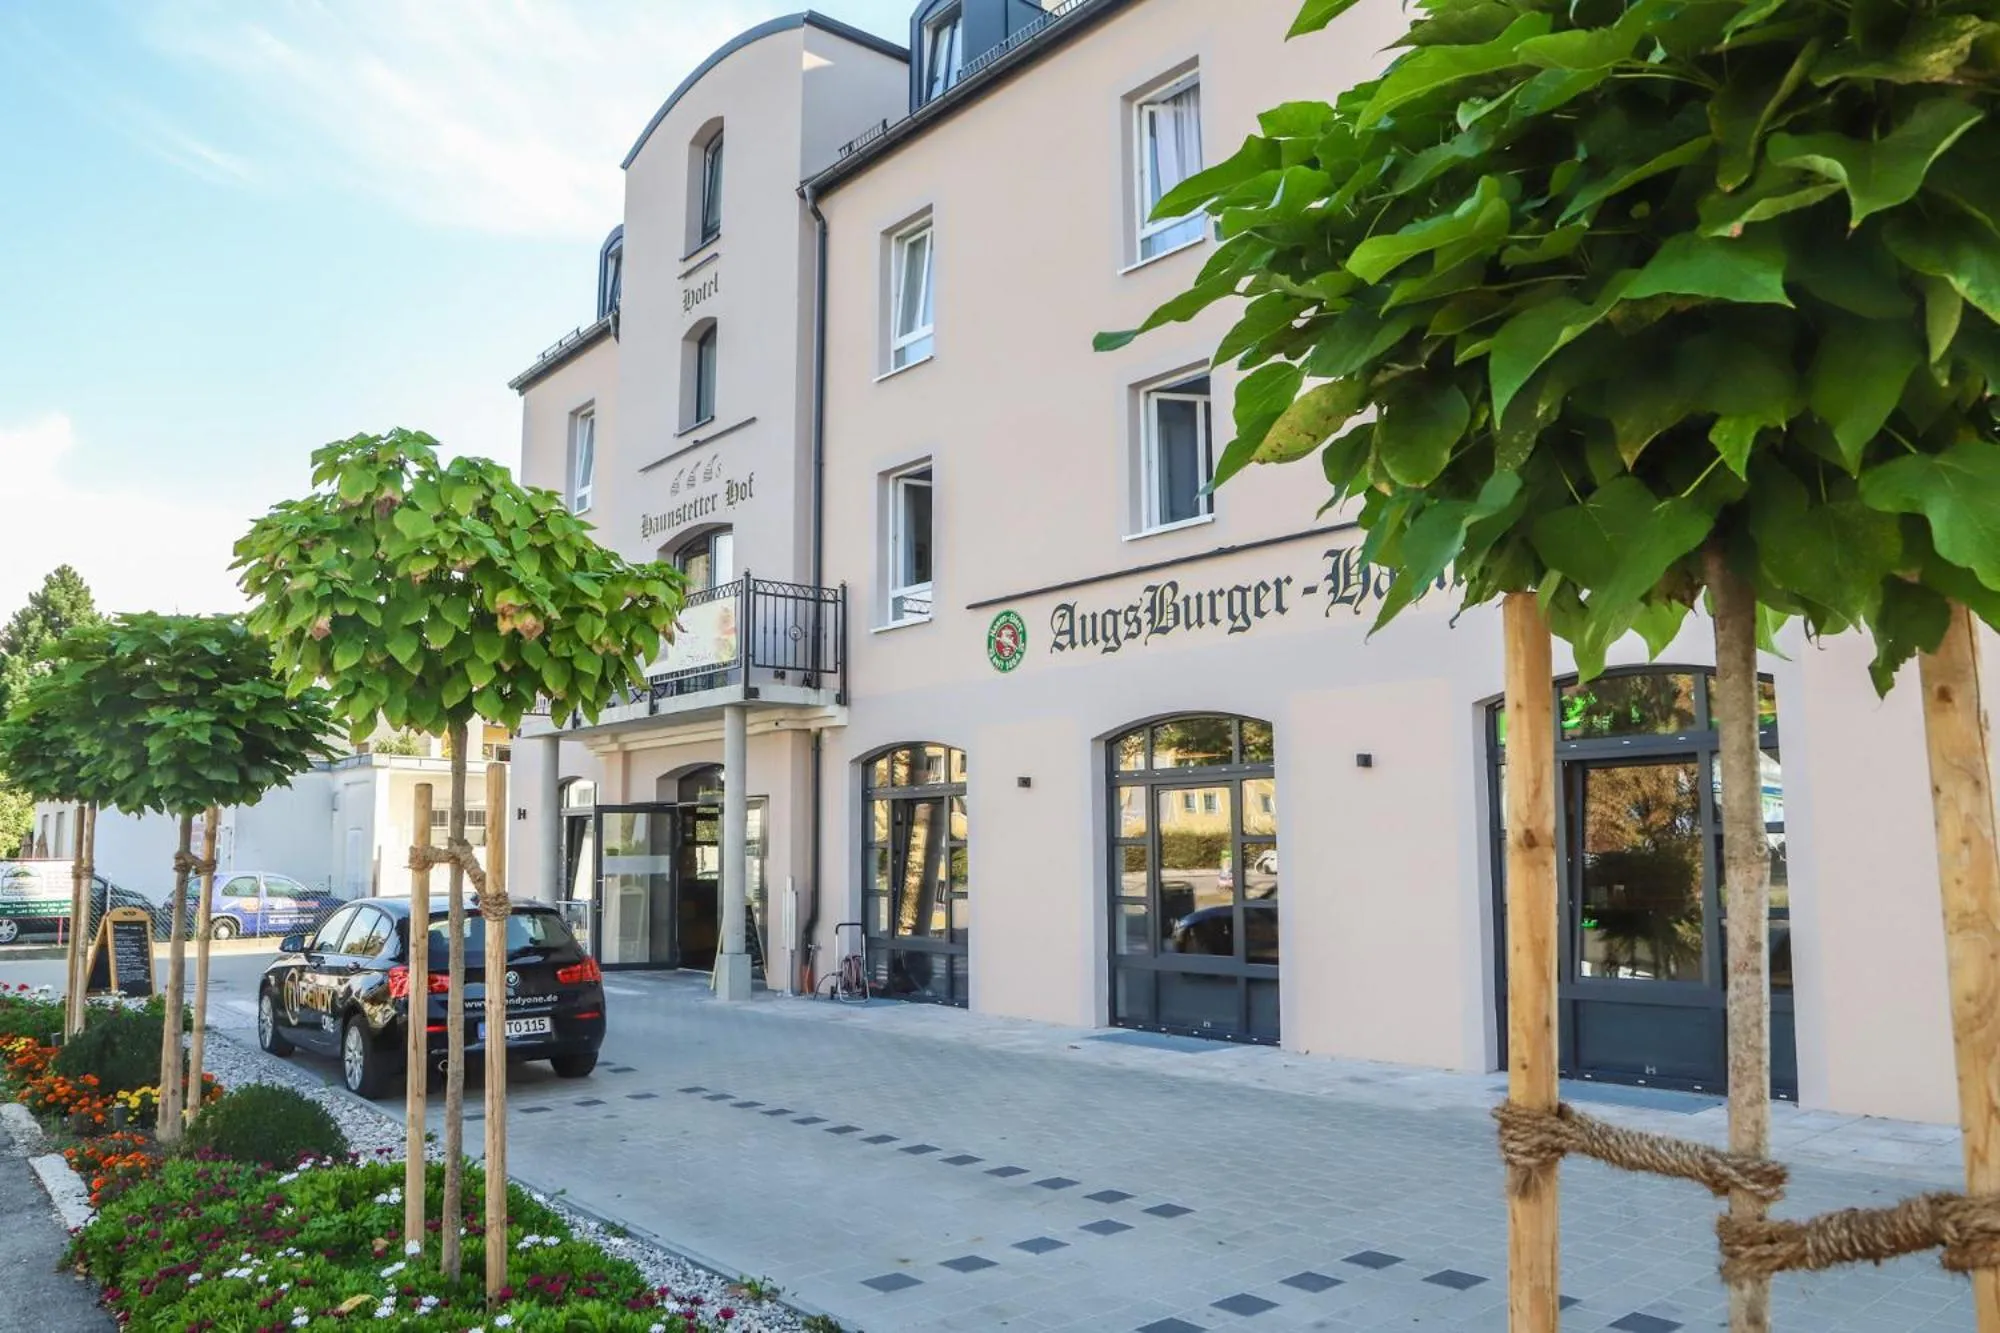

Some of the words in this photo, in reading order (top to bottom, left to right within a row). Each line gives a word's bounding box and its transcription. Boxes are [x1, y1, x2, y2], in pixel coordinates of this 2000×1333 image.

[682, 271, 719, 315] Hotel
[641, 493, 719, 541] Haunstetter
[725, 471, 754, 509] Hof
[507, 1021, 522, 1034] TO
[525, 1019, 546, 1032] 115
